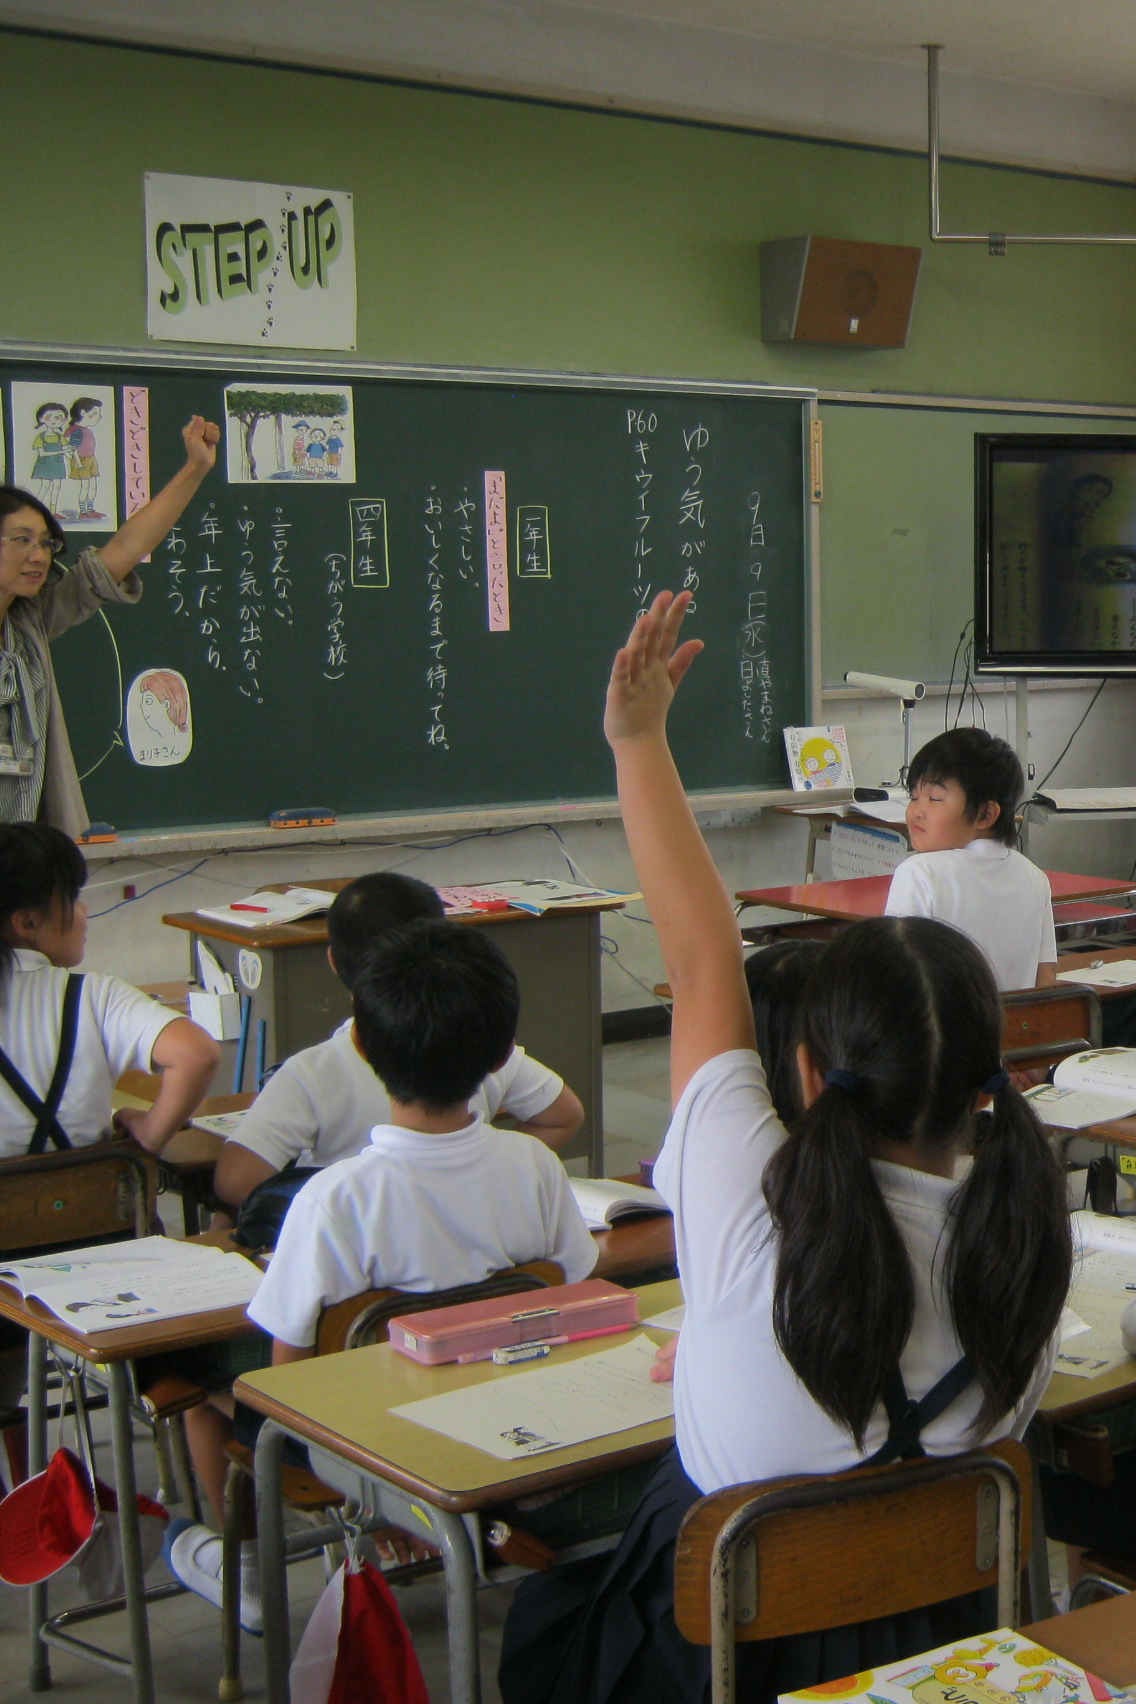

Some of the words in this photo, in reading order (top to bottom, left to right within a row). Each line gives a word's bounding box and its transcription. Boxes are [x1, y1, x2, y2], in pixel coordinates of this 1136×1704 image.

[155, 218, 276, 316] STEP
[286, 198, 344, 290] UP
[354, 503, 379, 577] 四年生
[523, 516, 547, 572] 一年生
